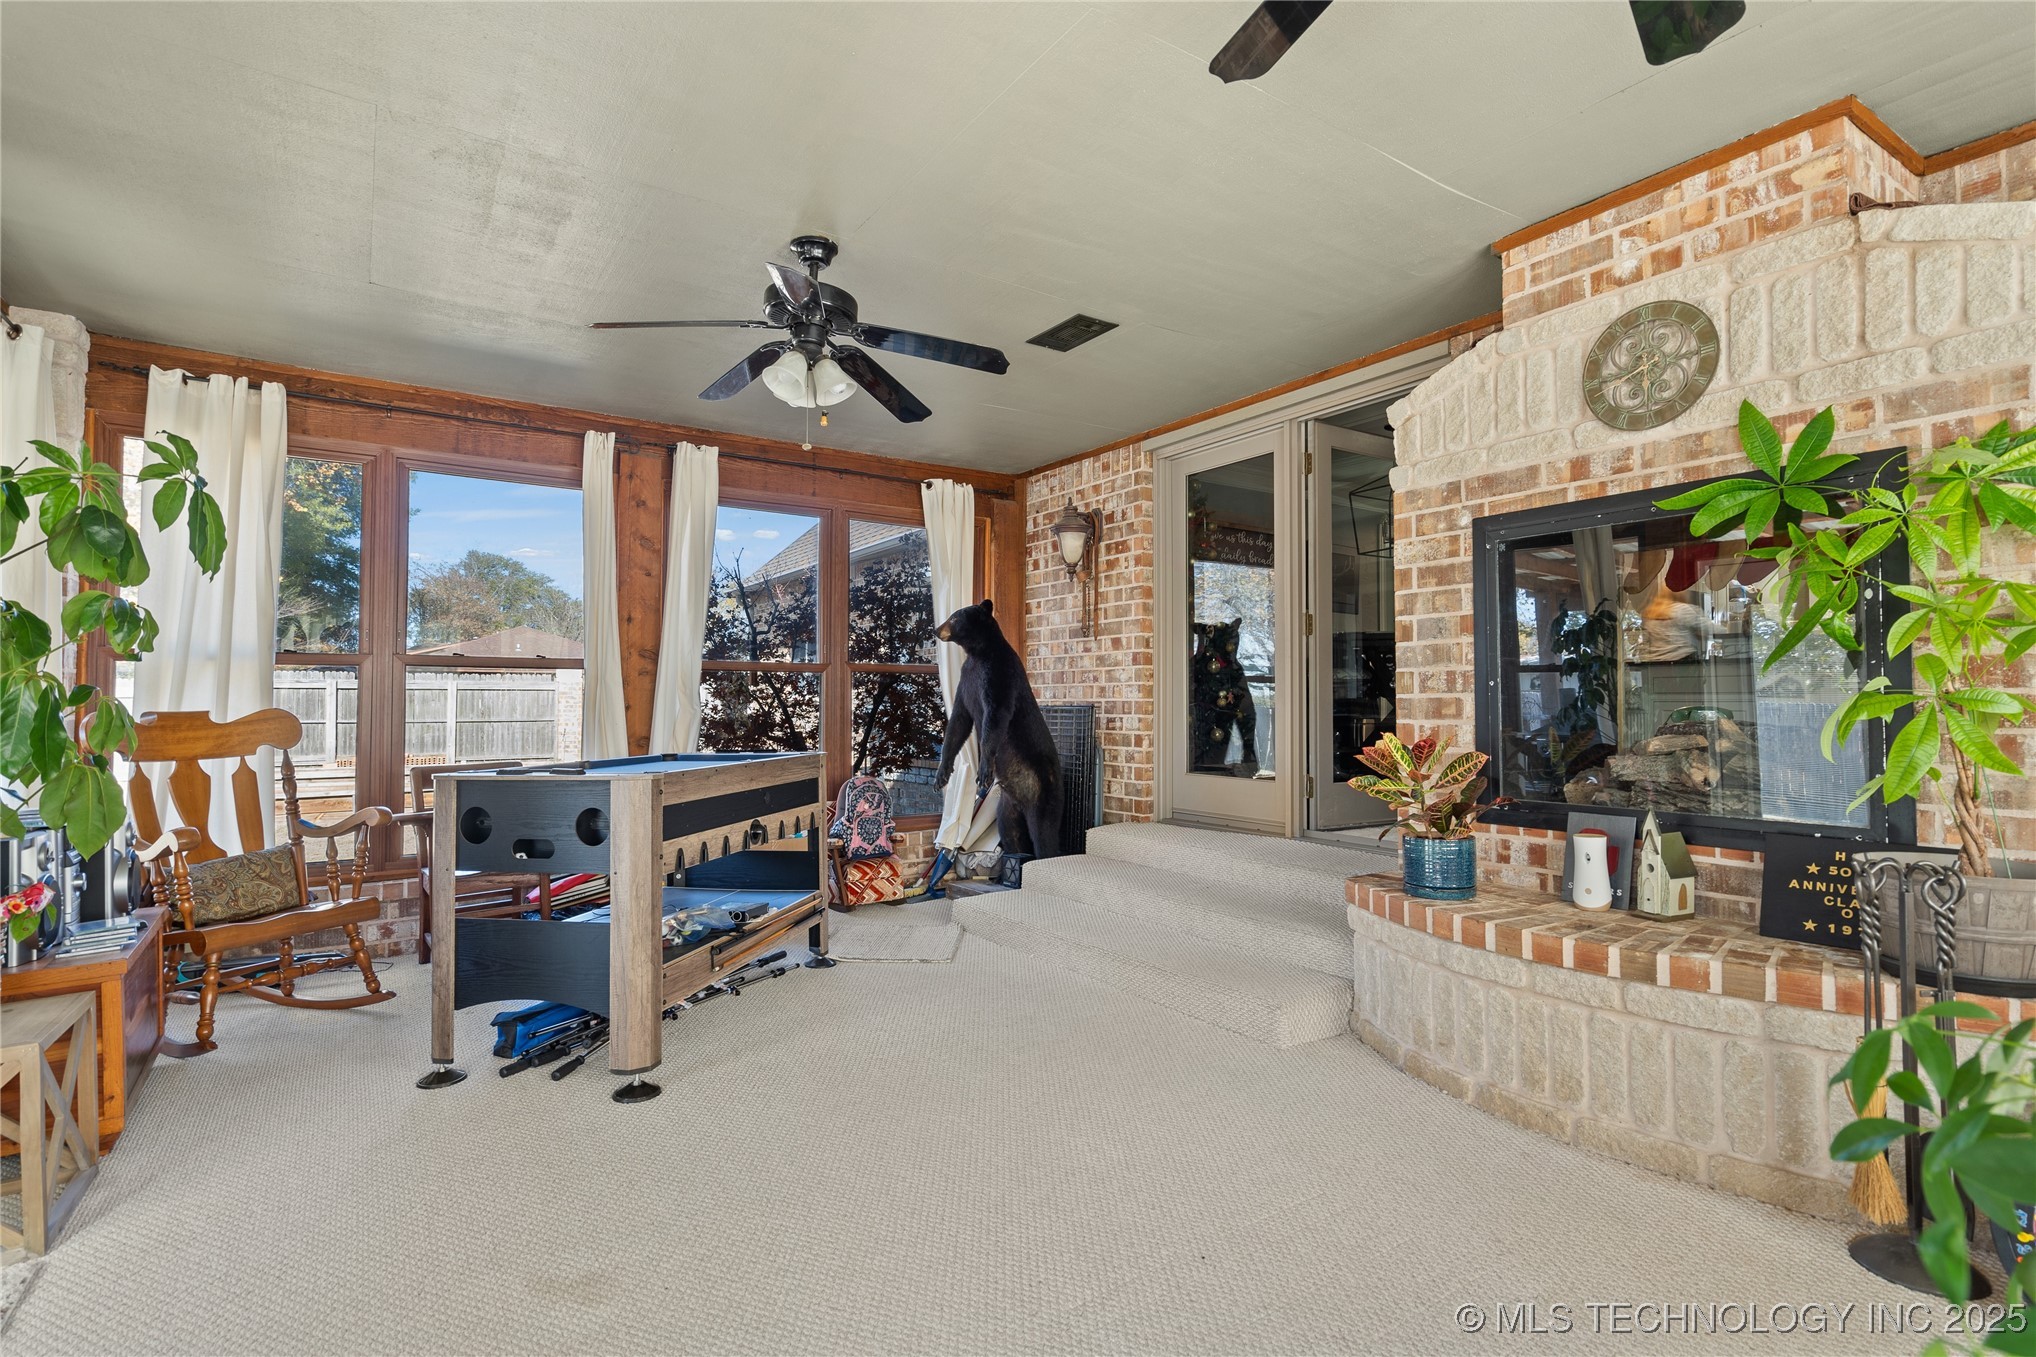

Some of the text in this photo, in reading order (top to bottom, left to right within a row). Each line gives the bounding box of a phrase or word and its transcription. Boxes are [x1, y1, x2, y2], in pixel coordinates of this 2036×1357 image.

[1236, 531, 1254, 546] this
[1255, 534, 1274, 552] day
[1221, 547, 1246, 565] daily
[1788, 879, 1857, 895] ANNIVE
[1824, 896, 1861, 909] CLA
[1828, 923, 1863, 935] 19
